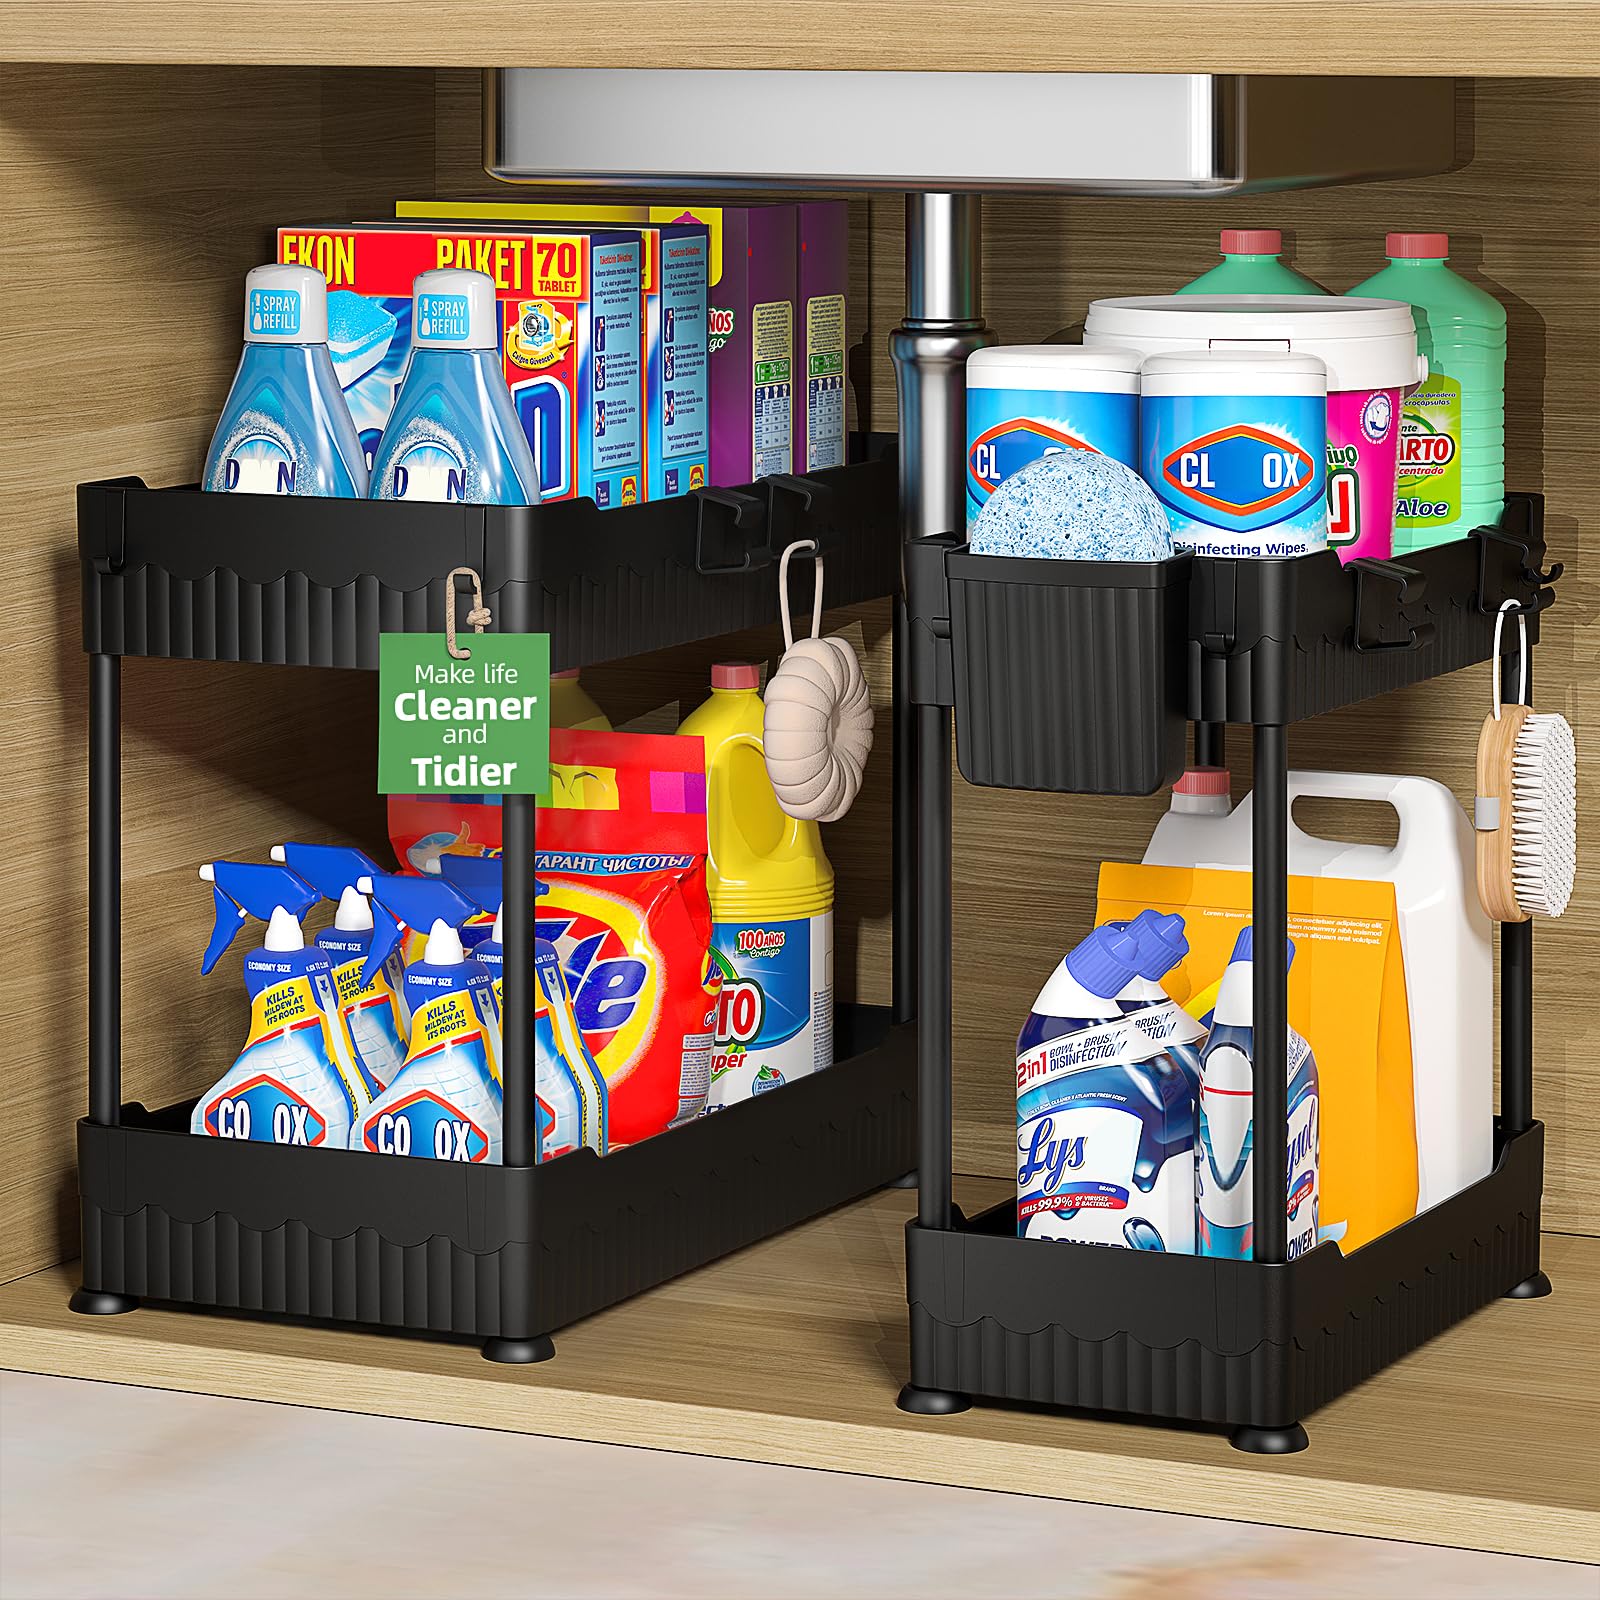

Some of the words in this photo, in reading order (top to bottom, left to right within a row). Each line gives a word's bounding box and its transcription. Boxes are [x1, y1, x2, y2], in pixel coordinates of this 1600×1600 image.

[437, 239, 525, 290] PAKET
[537, 242, 577, 278] 70
[538, 279, 577, 293] TABLET
[263, 296, 296, 312] SPRAY
[431, 301, 466, 316] SPRAY
[263, 313, 296, 329] REFILL
[431, 318, 466, 335] REFILL
[976, 444, 1000, 479] CL
[1180, 453, 1215, 488] CL
[1262, 453, 1300, 488] OX
[1396, 499, 1448, 516] Aloe
[415, 663, 474, 684] Make
[484, 662, 518, 684] life
[394, 689, 537, 721] Cleaner
[442, 723, 487, 744] and
[410, 755, 517, 786] Tidier
[318, 940, 346, 950] ECONOMY
[347, 943, 361, 952] SIZE
[738, 930, 764, 950] 100
[750, 948, 780, 958] Contigo
[248, 961, 276, 972] ECONOMY
[277, 964, 291, 973] SIZE
[337, 965, 363, 985] KILLS
[408, 975, 437, 986] ECONOMY
[437, 977, 452, 987] SIZE
[264, 999, 292, 1018] MILDEW
[293, 995, 303, 1005] AT
[266, 986, 295, 1007] KILLS
[267, 1015, 277, 1026] ITS
[278, 1004, 305, 1020] ROOTS
[424, 1013, 453, 1032] MILDEW
[455, 1009, 465, 1020] AT
[427, 1000, 456, 1021] KILLS
[427, 1029, 438, 1040] ITS
[439, 1019, 467, 1035] ROOTS
[1050, 1043, 1074, 1058] BOWL
[1050, 1040, 1128, 1072] DISINFECTION
[1017, 1051, 1047, 1088] 2in1
[218, 1098, 250, 1139] CO
[273, 1104, 309, 1145] OX
[377, 1114, 411, 1156] CO
[434, 1119, 471, 1162] OX
[1018, 1117, 1087, 1193] Lys
[1098, 1185, 1116, 1193] BRAND
[1021, 1203, 1038, 1215] KILLS
[1038, 1196, 1072, 1211] 99.9%
